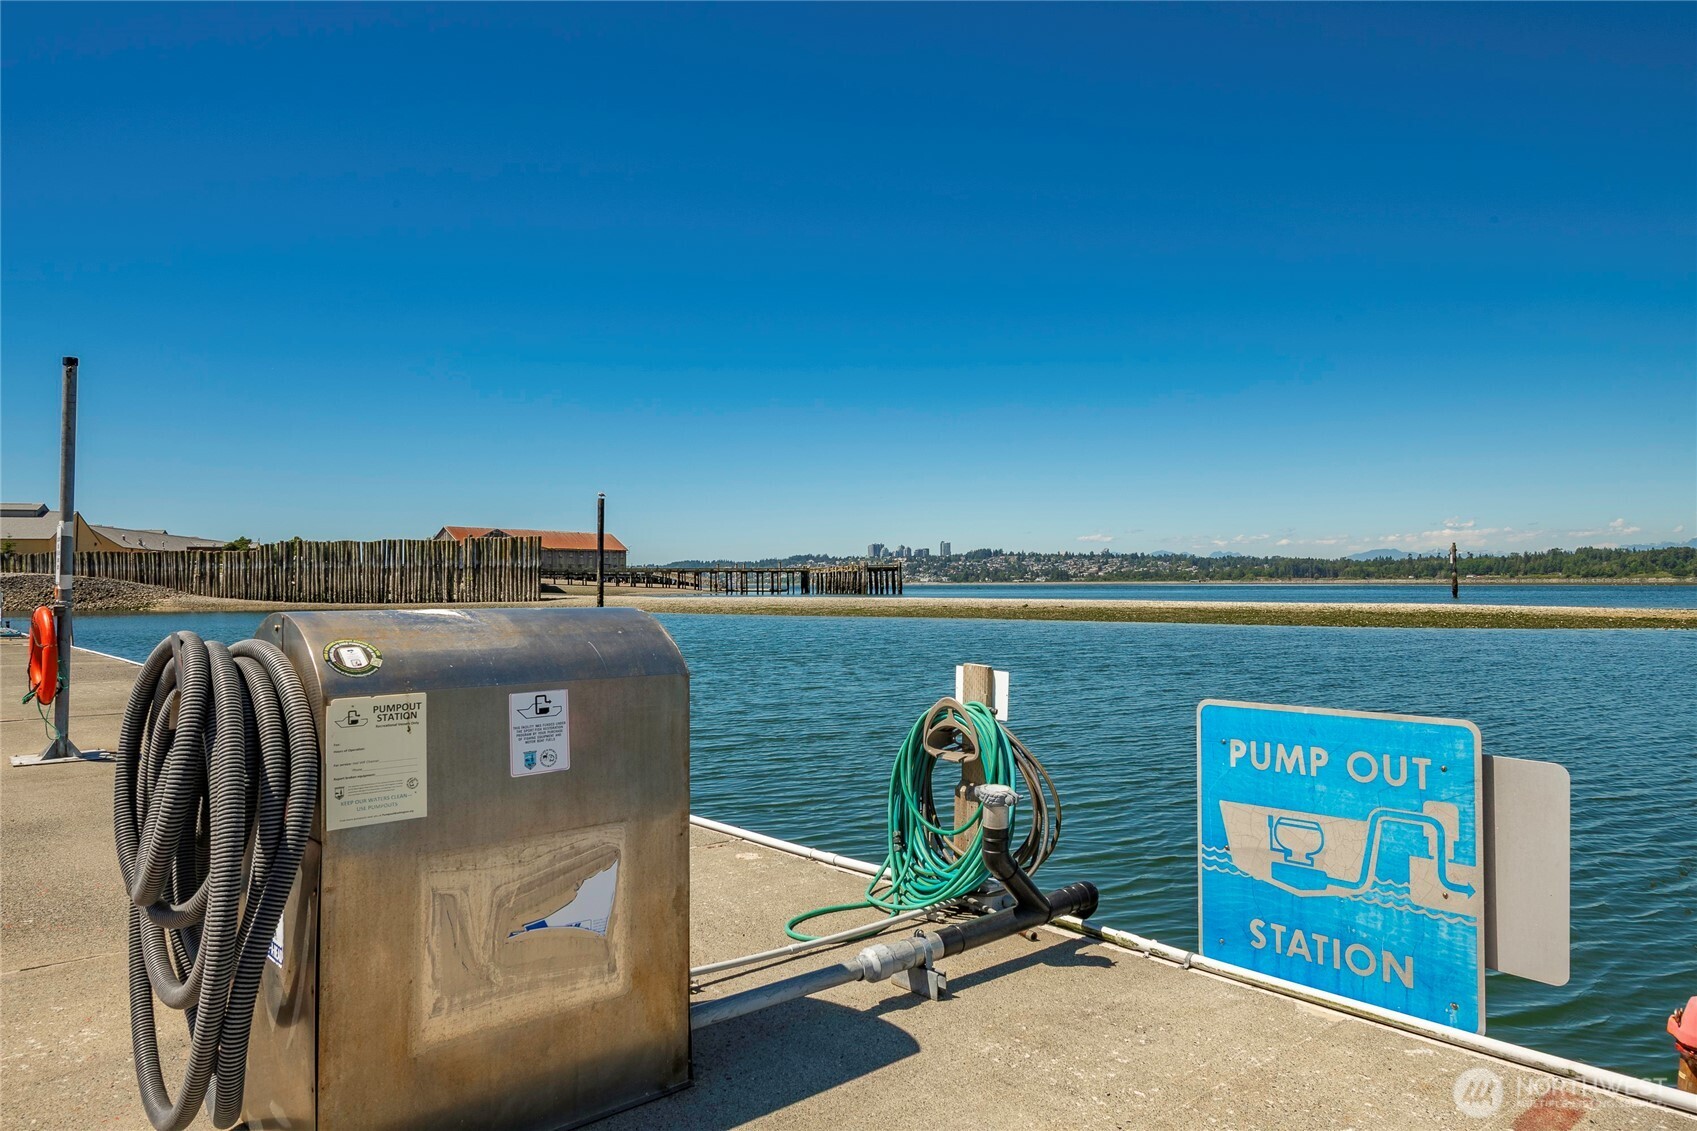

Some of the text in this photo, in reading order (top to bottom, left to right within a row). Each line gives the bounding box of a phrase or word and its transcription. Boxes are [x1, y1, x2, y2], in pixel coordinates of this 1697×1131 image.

[373, 702, 422, 714] PUMPOUT
[377, 711, 418, 723] STATION
[1230, 738, 1431, 790] PUMP OUT
[367, 802, 398, 810] PUMPOUTS
[1249, 919, 1414, 989] STATION
